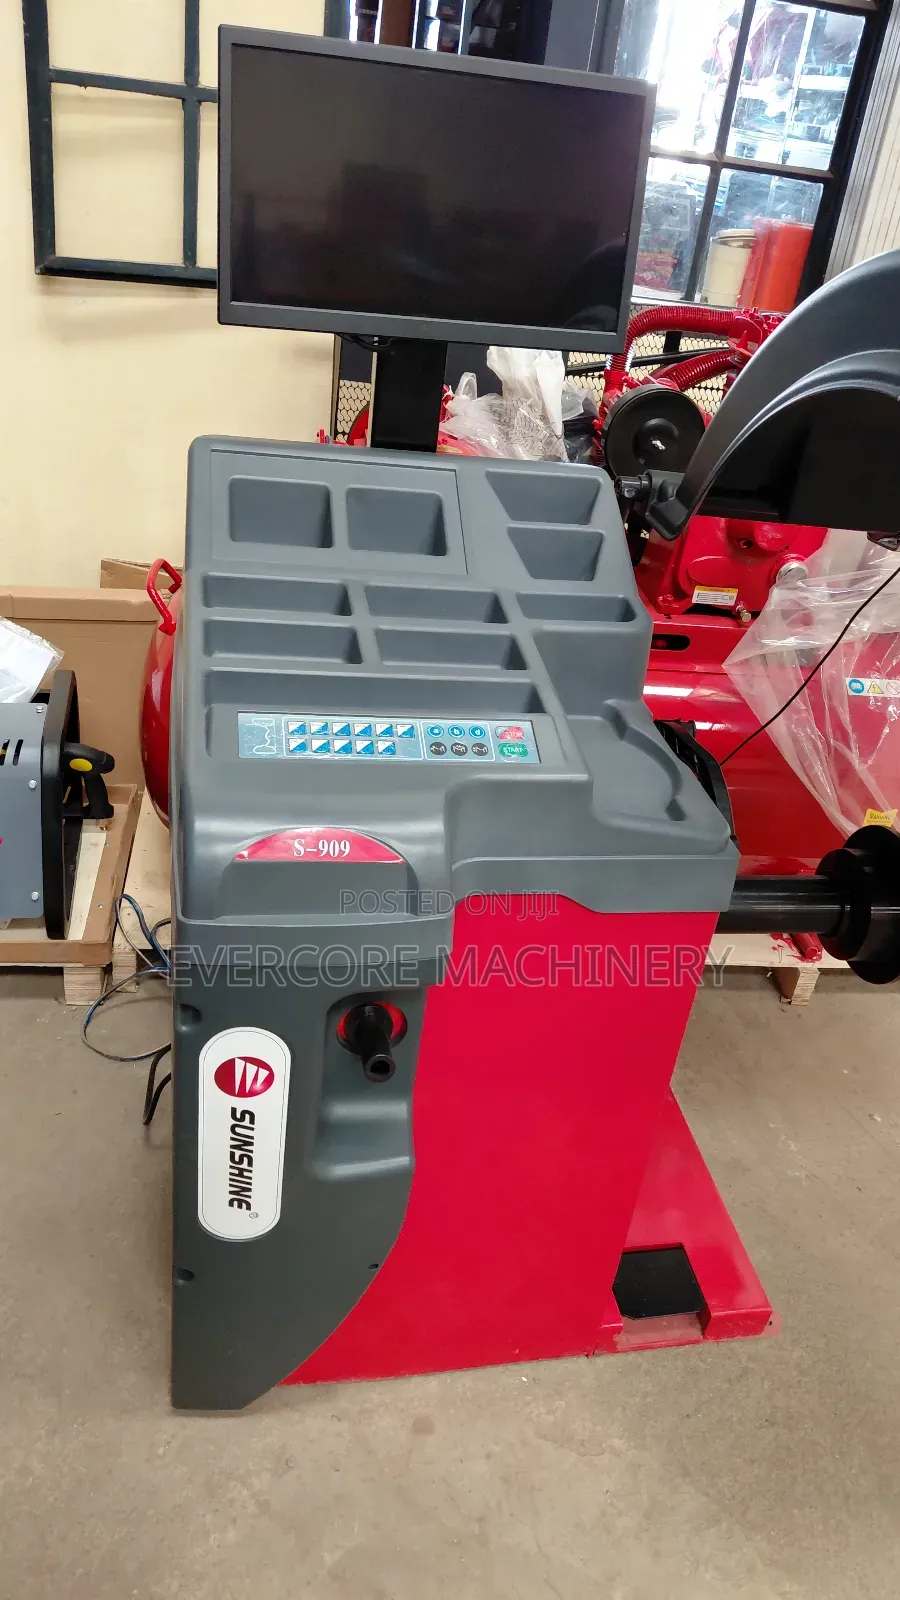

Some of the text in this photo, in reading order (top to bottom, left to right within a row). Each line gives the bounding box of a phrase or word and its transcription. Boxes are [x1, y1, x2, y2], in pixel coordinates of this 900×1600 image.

[503, 746, 524, 754] START
[293, 838, 351, 858] S-909
[228, 1106, 256, 1212] SUNSHINE
